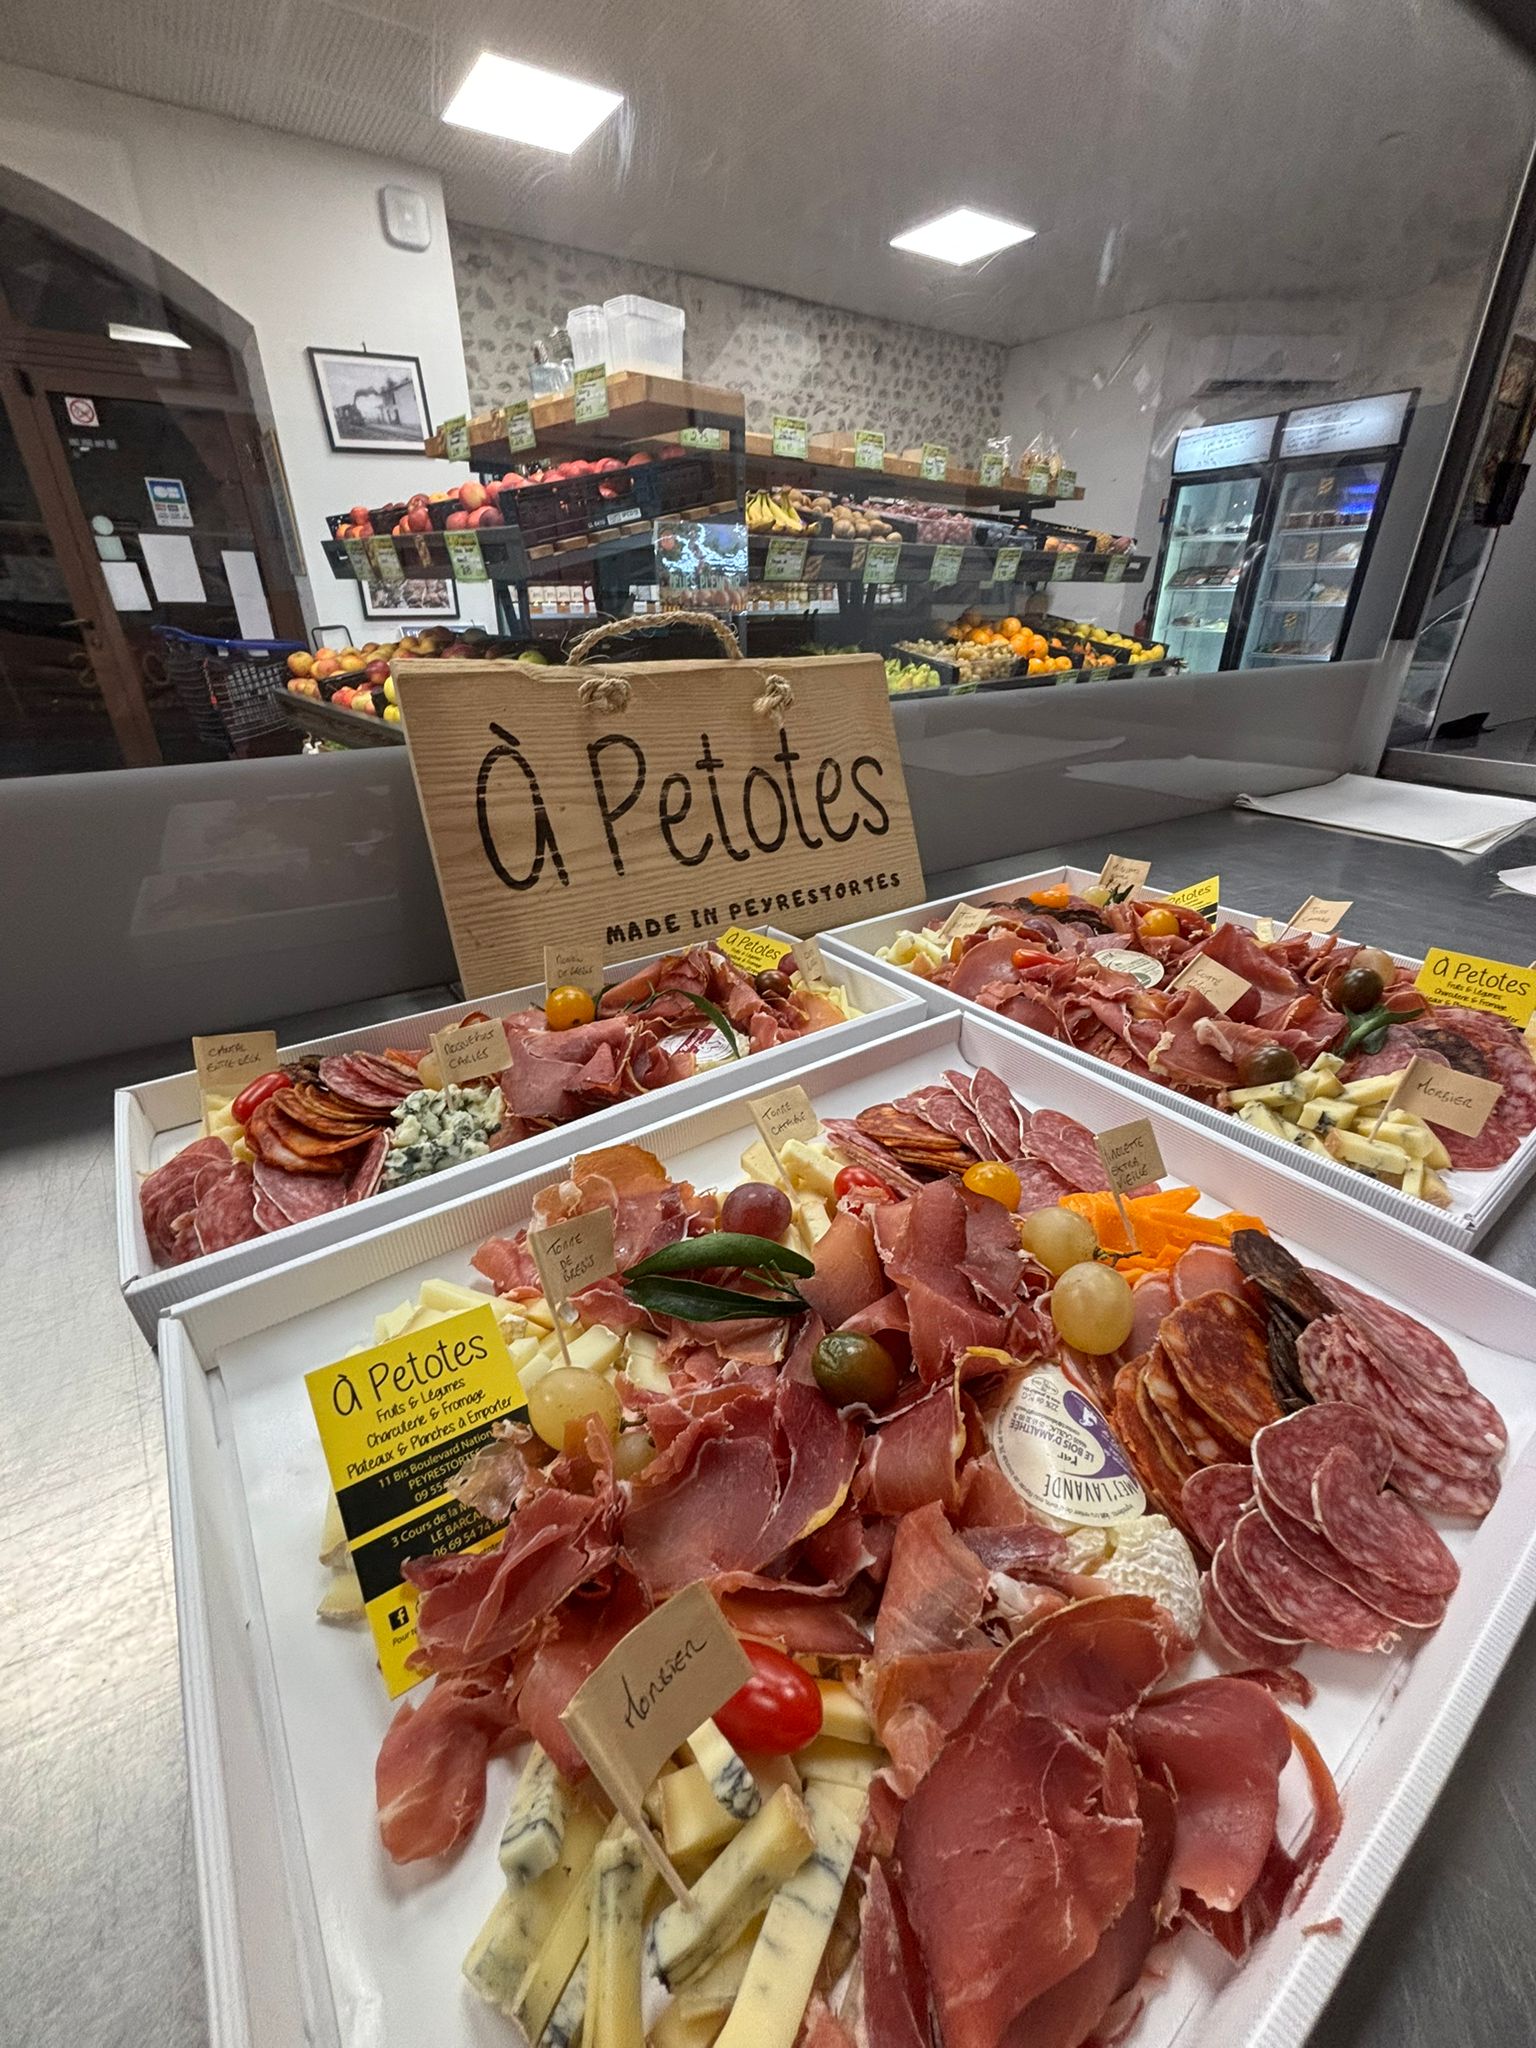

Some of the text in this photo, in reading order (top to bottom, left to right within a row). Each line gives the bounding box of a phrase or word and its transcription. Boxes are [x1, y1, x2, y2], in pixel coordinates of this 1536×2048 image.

[476, 722, 890, 890] À Petotes
[606, 872, 901, 945] MADE IN PEYRESTORTES
[737, 936, 781, 960] Petotes
[1432, 956, 1531, 996] À Petotes
[1446, 981, 1464, 992] Fruits
[333, 1335, 488, 1416] À Petotes
[366, 1387, 486, 1448] Charcuterie & Fromage
[376, 1377, 466, 1423] Fruits & Légumes
[346, 1395, 513, 1479] Plateaux & Planches à Emporter
[1062, 1439, 1084, 1456] BOIS
[1084, 1451, 1095, 1463] LE
[378, 1430, 492, 1488] 11 Bis Boulevard Nation
[414, 1490, 428, 1502] 09
[391, 1536, 400, 1548] 3
[401, 1522, 432, 1542] Cours
[433, 1514, 447, 1527] de
[448, 1507, 458, 1520] la
[430, 1529, 446, 1544] LE
[448, 1537, 463, 1550] 69
[463, 1530, 477, 1544] 54
[477, 1522, 492, 1536] 74
